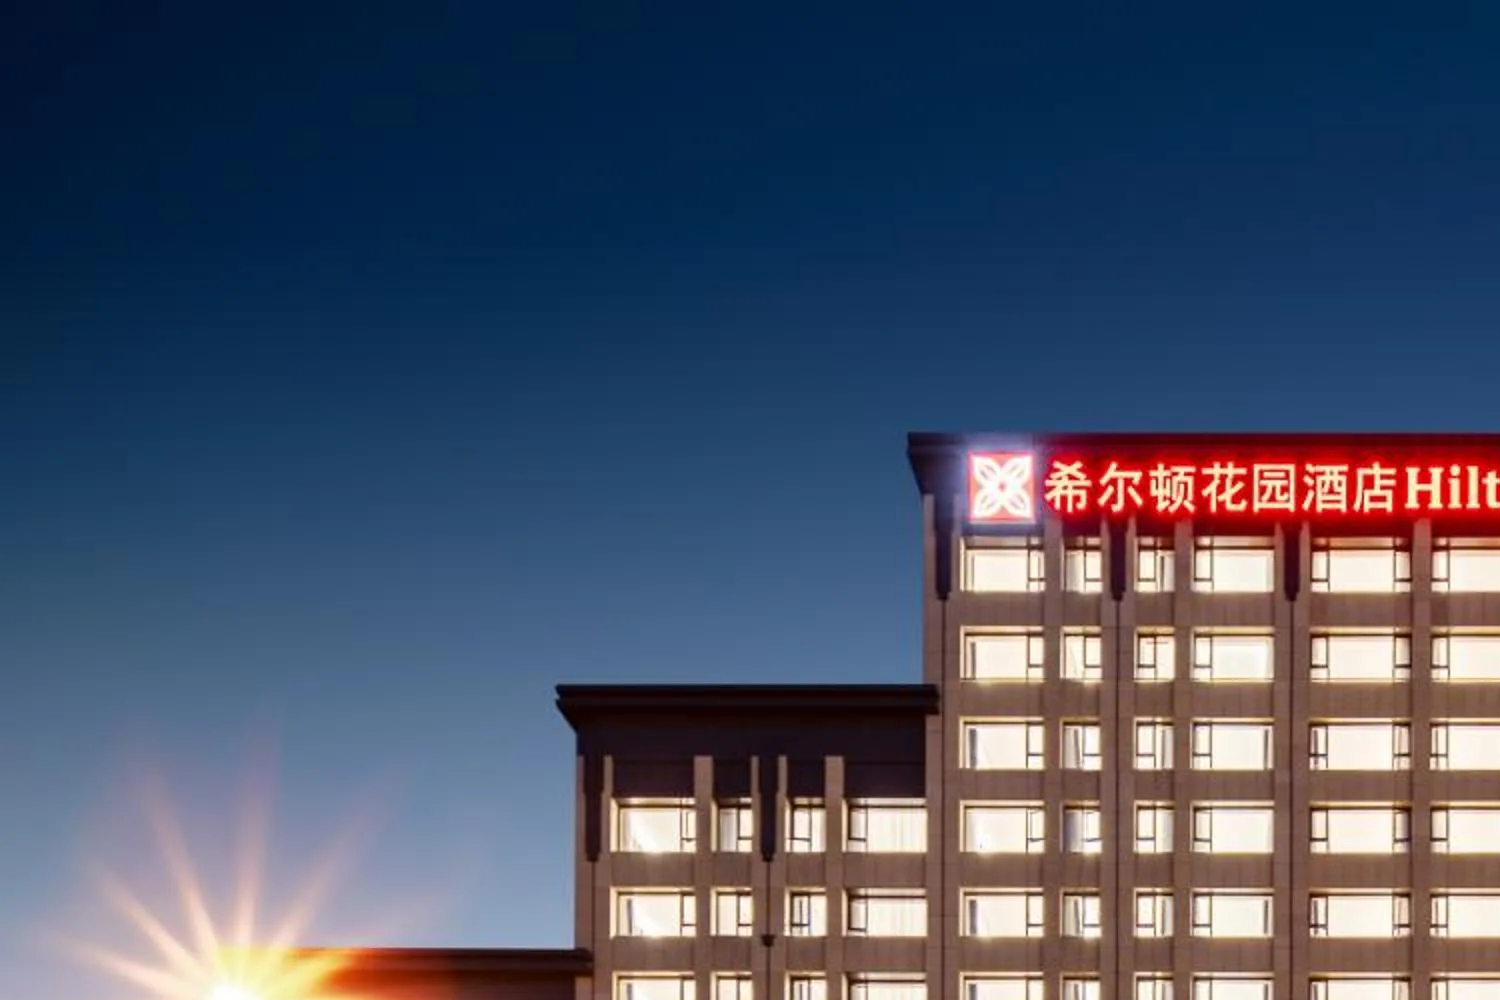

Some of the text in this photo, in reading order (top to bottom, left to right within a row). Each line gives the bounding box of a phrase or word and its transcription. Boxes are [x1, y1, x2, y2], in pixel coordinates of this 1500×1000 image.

[1044, 461, 1396, 513] 希尔顿花园酒店
